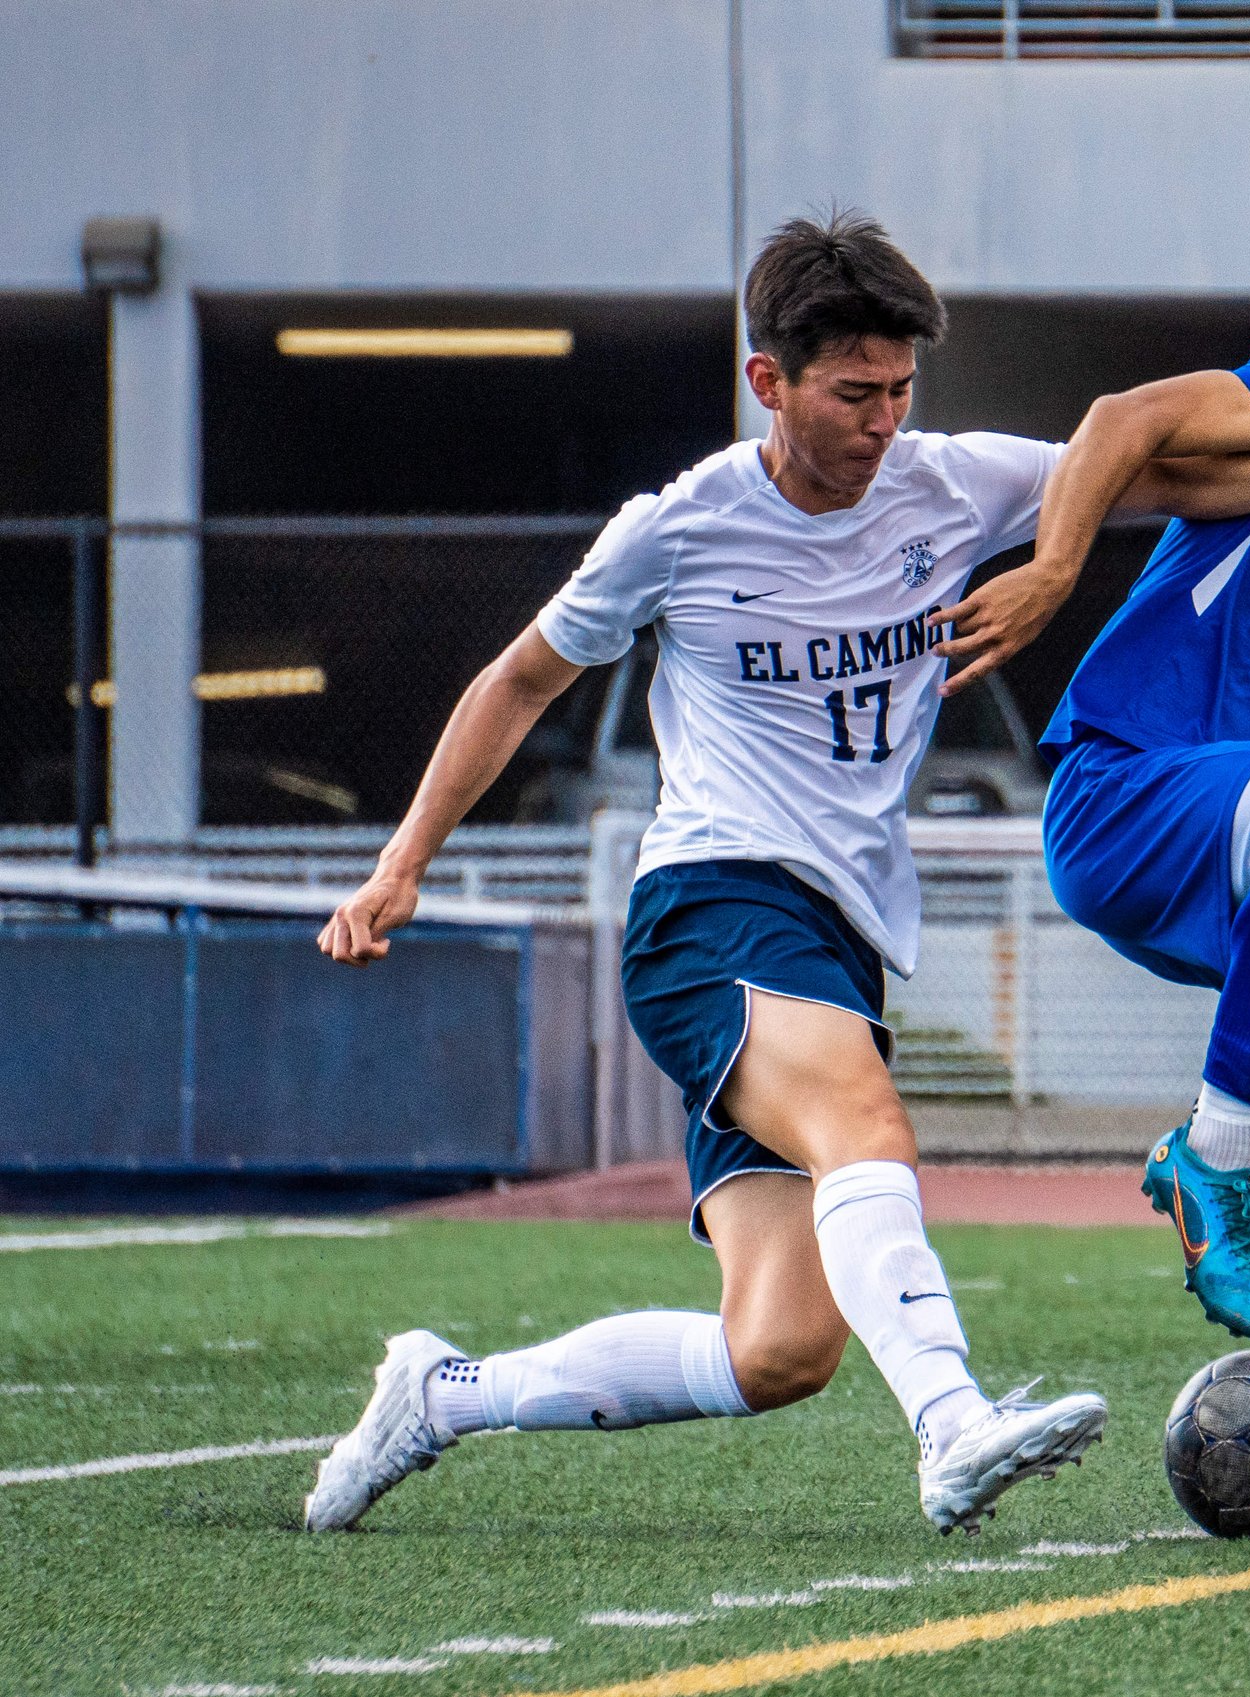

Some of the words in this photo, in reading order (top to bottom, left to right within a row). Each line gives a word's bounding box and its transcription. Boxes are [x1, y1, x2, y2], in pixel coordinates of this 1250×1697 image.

[736, 641, 799, 682] EL
[806, 605, 944, 681] CAMINO
[824, 679, 893, 763] 17
